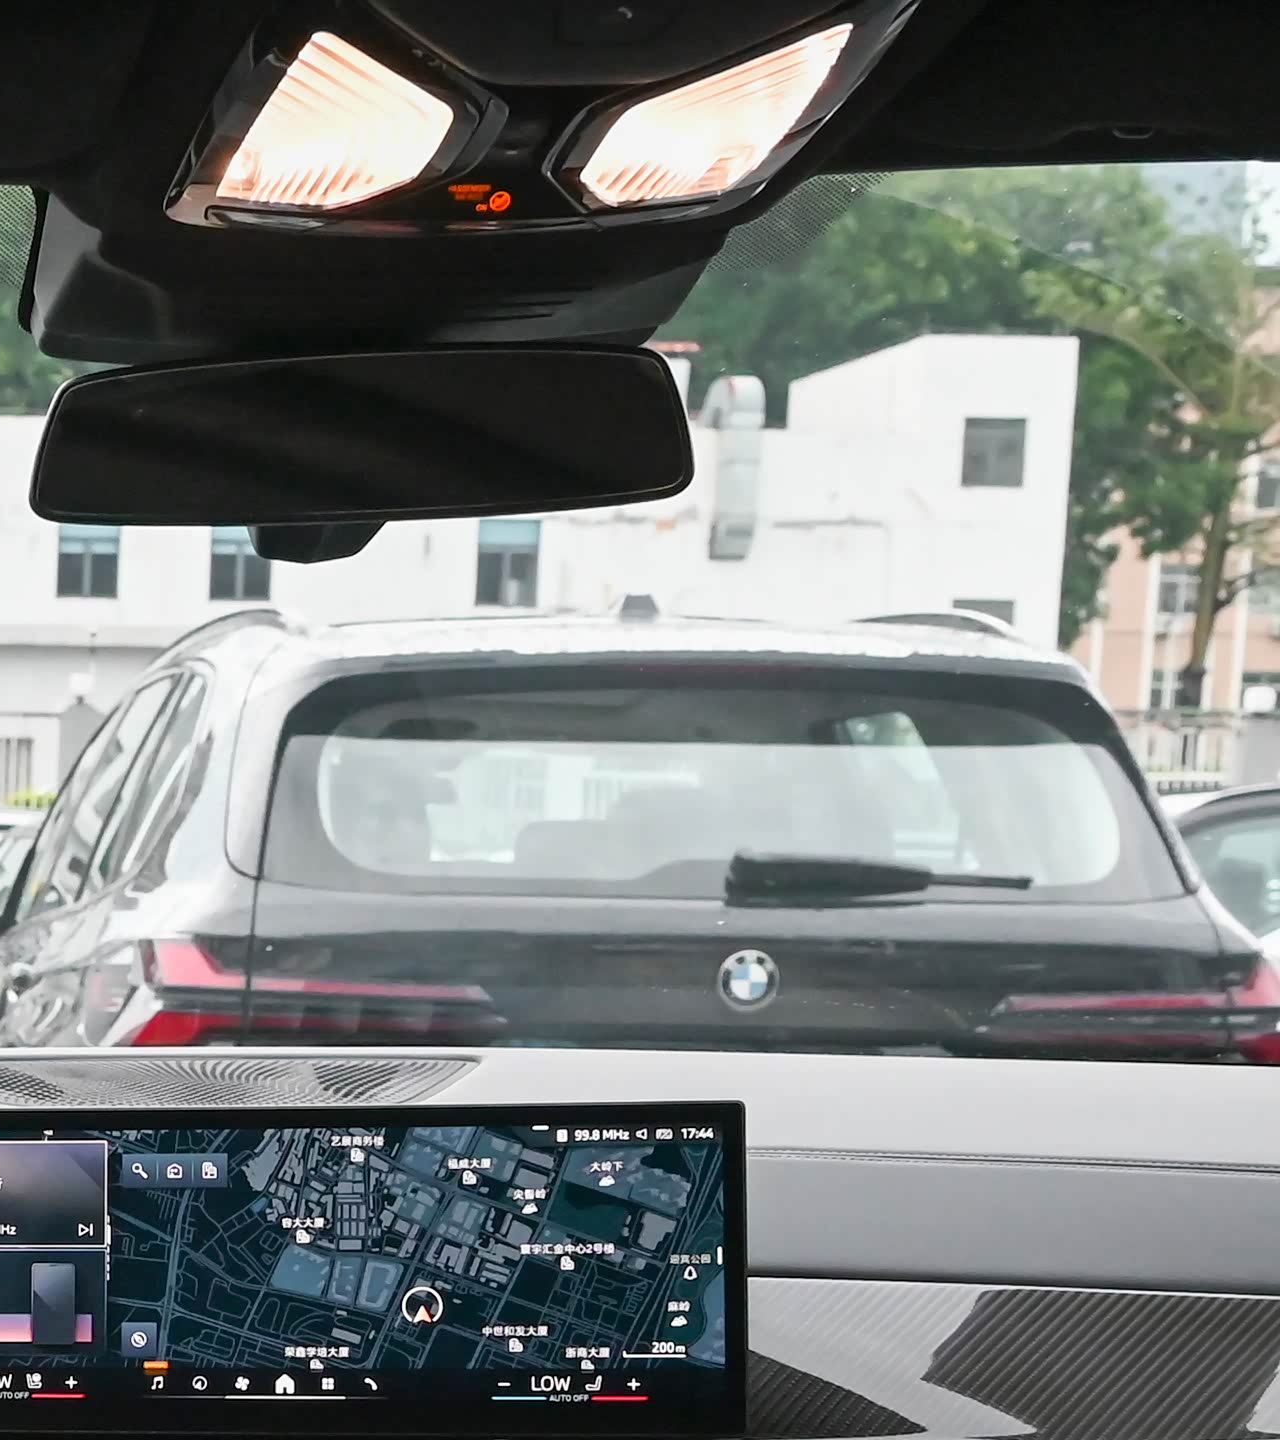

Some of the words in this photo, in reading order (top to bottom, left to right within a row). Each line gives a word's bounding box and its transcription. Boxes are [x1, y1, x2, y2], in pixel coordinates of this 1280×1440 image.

[574, 1129, 600, 1141] 99.8
[602, 1129, 630, 1141] MHz
[680, 1127, 715, 1139] 17:44
[531, 1375, 571, 1392] LOW
[14, 1391, 30, 1400] OFF
[548, 1394, 571, 1402] AUTO
[572, 1394, 590, 1402] OFF
